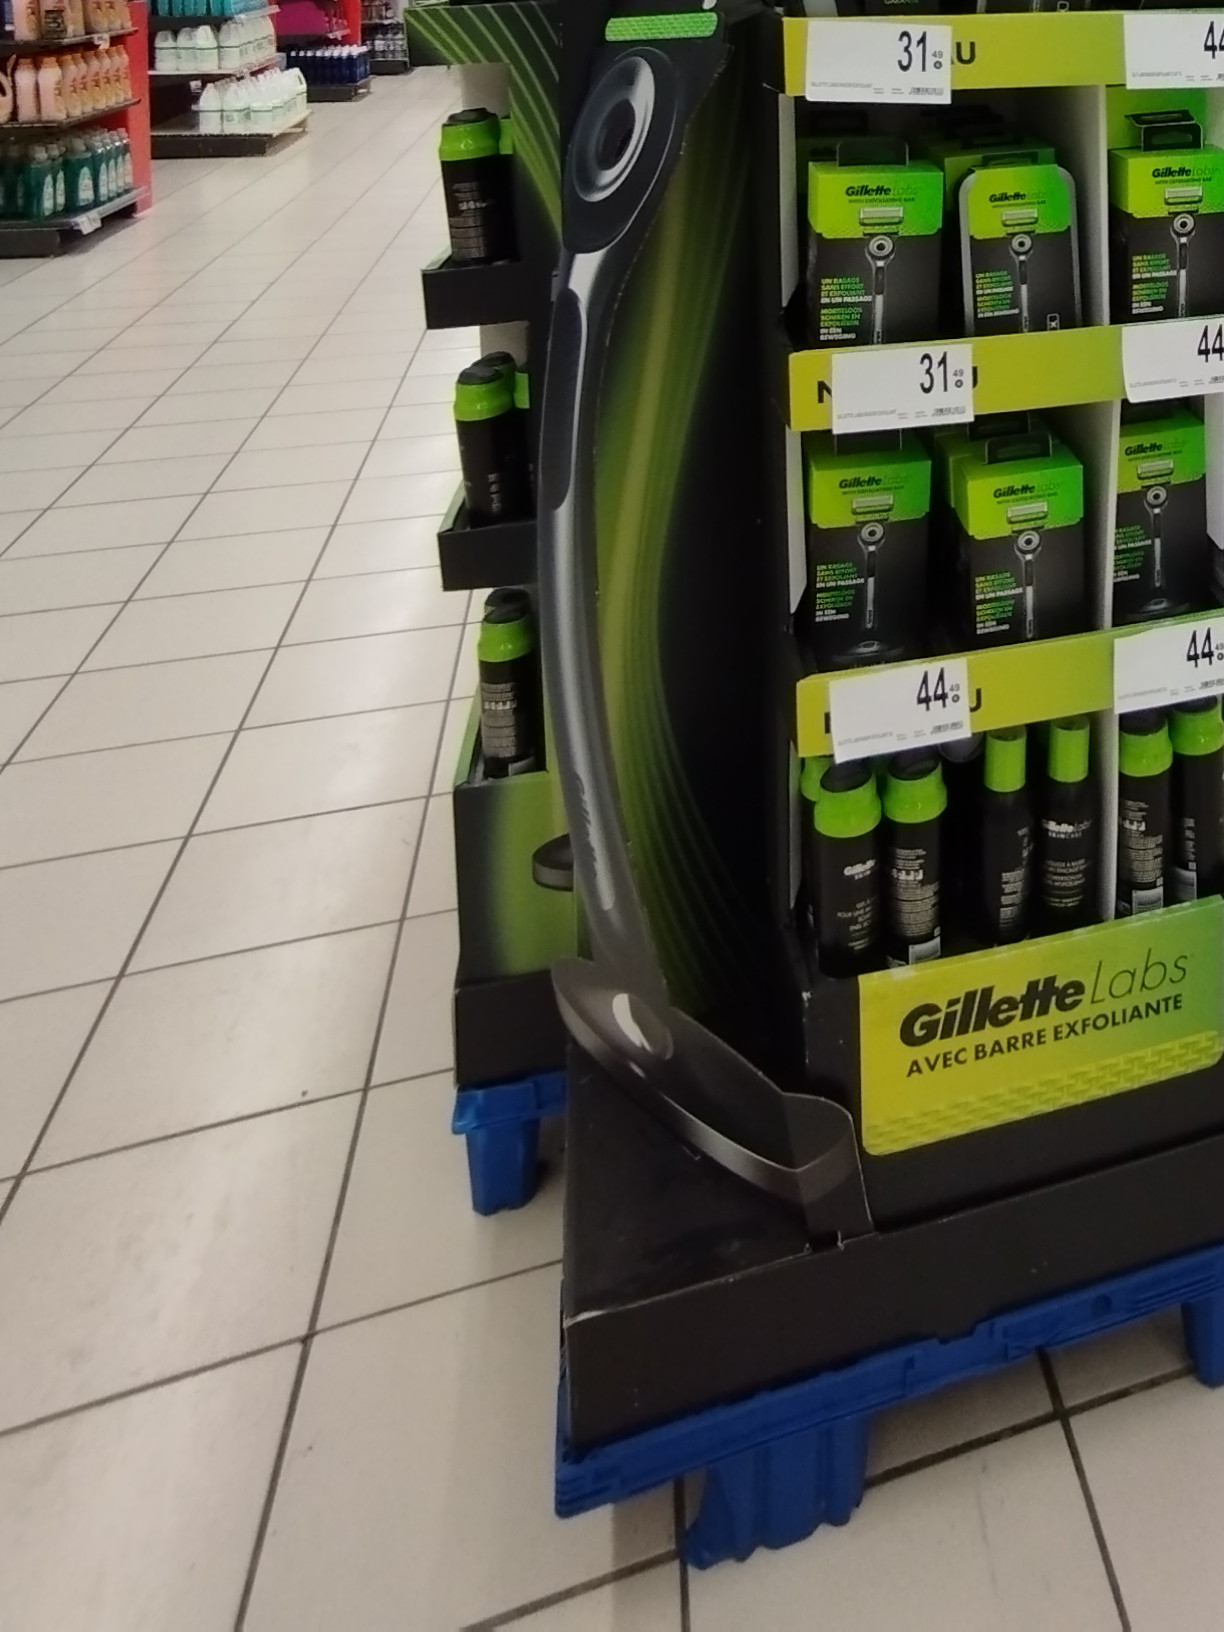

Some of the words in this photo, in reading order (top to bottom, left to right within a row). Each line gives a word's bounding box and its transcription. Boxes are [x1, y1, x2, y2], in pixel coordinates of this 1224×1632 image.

[898, 30, 927, 72] 31
[932, 51, 943, 59] 49
[1197, 324, 1224, 363] 44
[920, 352, 948, 394] 31
[953, 369, 964, 377] 49
[1187, 627, 1214, 668] 44
[1215, 643, 1224, 651] 49
[917, 667, 948, 711] 44
[949, 684, 960, 692] 49
[906, 1047, 968, 1078] AVEC
[974, 1028, 1047, 1060] BARRE
[1053, 993, 1184, 1042] EXFOLIANTE
